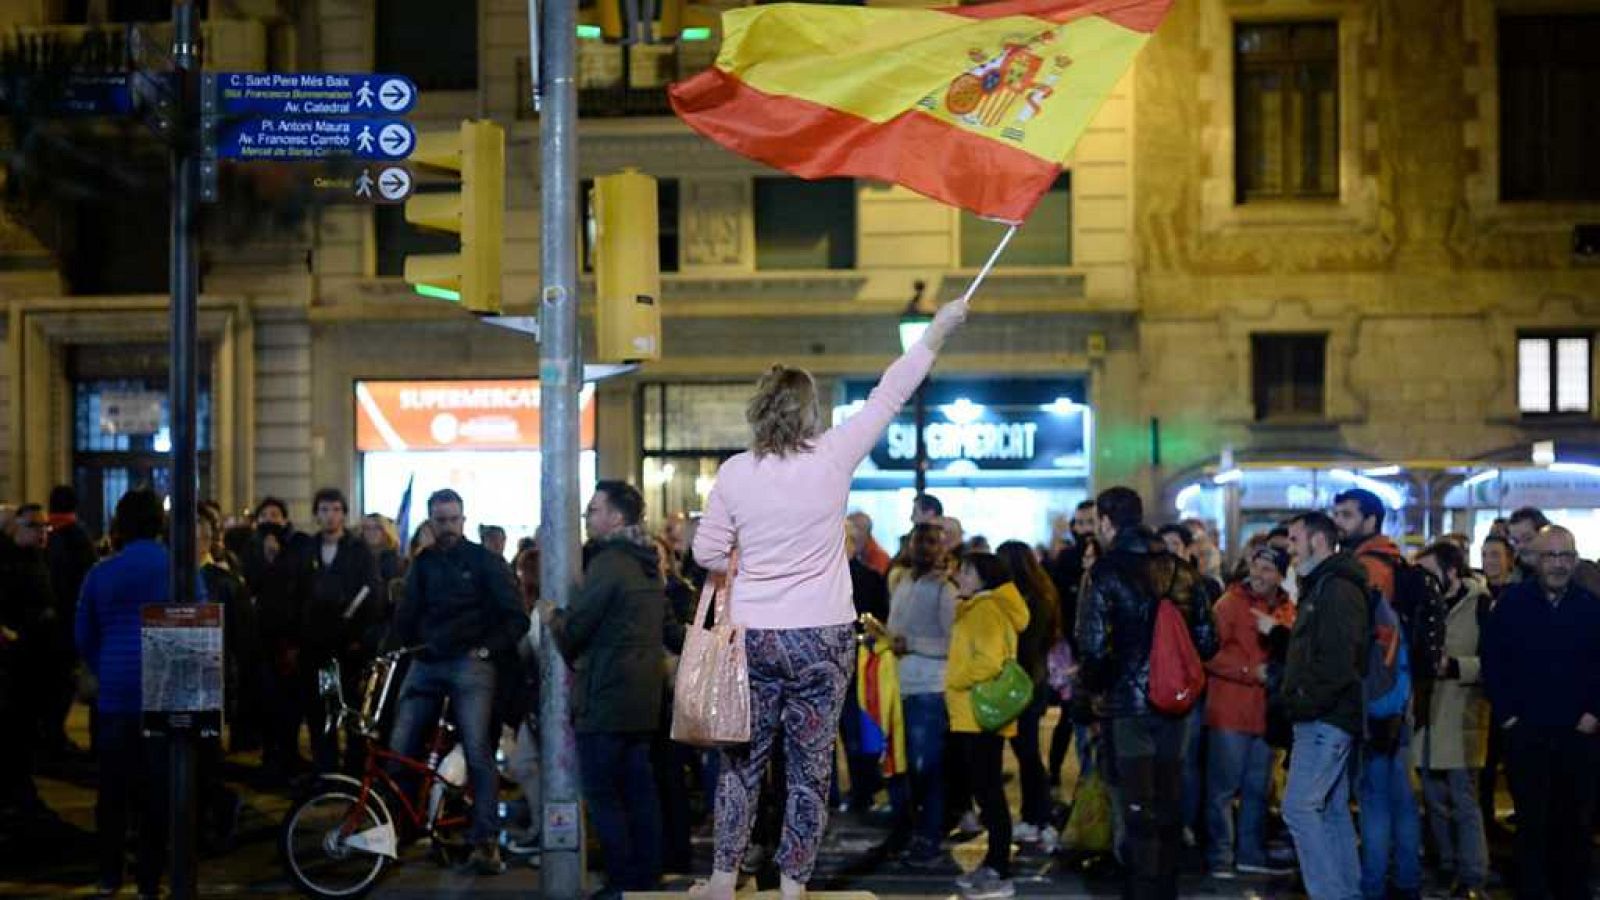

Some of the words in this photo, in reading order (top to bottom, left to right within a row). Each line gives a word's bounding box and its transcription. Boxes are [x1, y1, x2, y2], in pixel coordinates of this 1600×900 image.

[230, 74, 244, 86] C.
[246, 74, 271, 86] Sant
[272, 74, 298, 86] Pere
[325, 74, 350, 86] Baix
[284, 101, 301, 112] Av.
[304, 101, 350, 113] Catedral
[278, 120, 312, 131] Antoni
[315, 120, 350, 132] Maura
[239, 133, 254, 145] Av.
[258, 133, 308, 145] Francesc
[310, 133, 350, 145] Cambó
[887, 422, 1038, 459] SUERMERCAT
